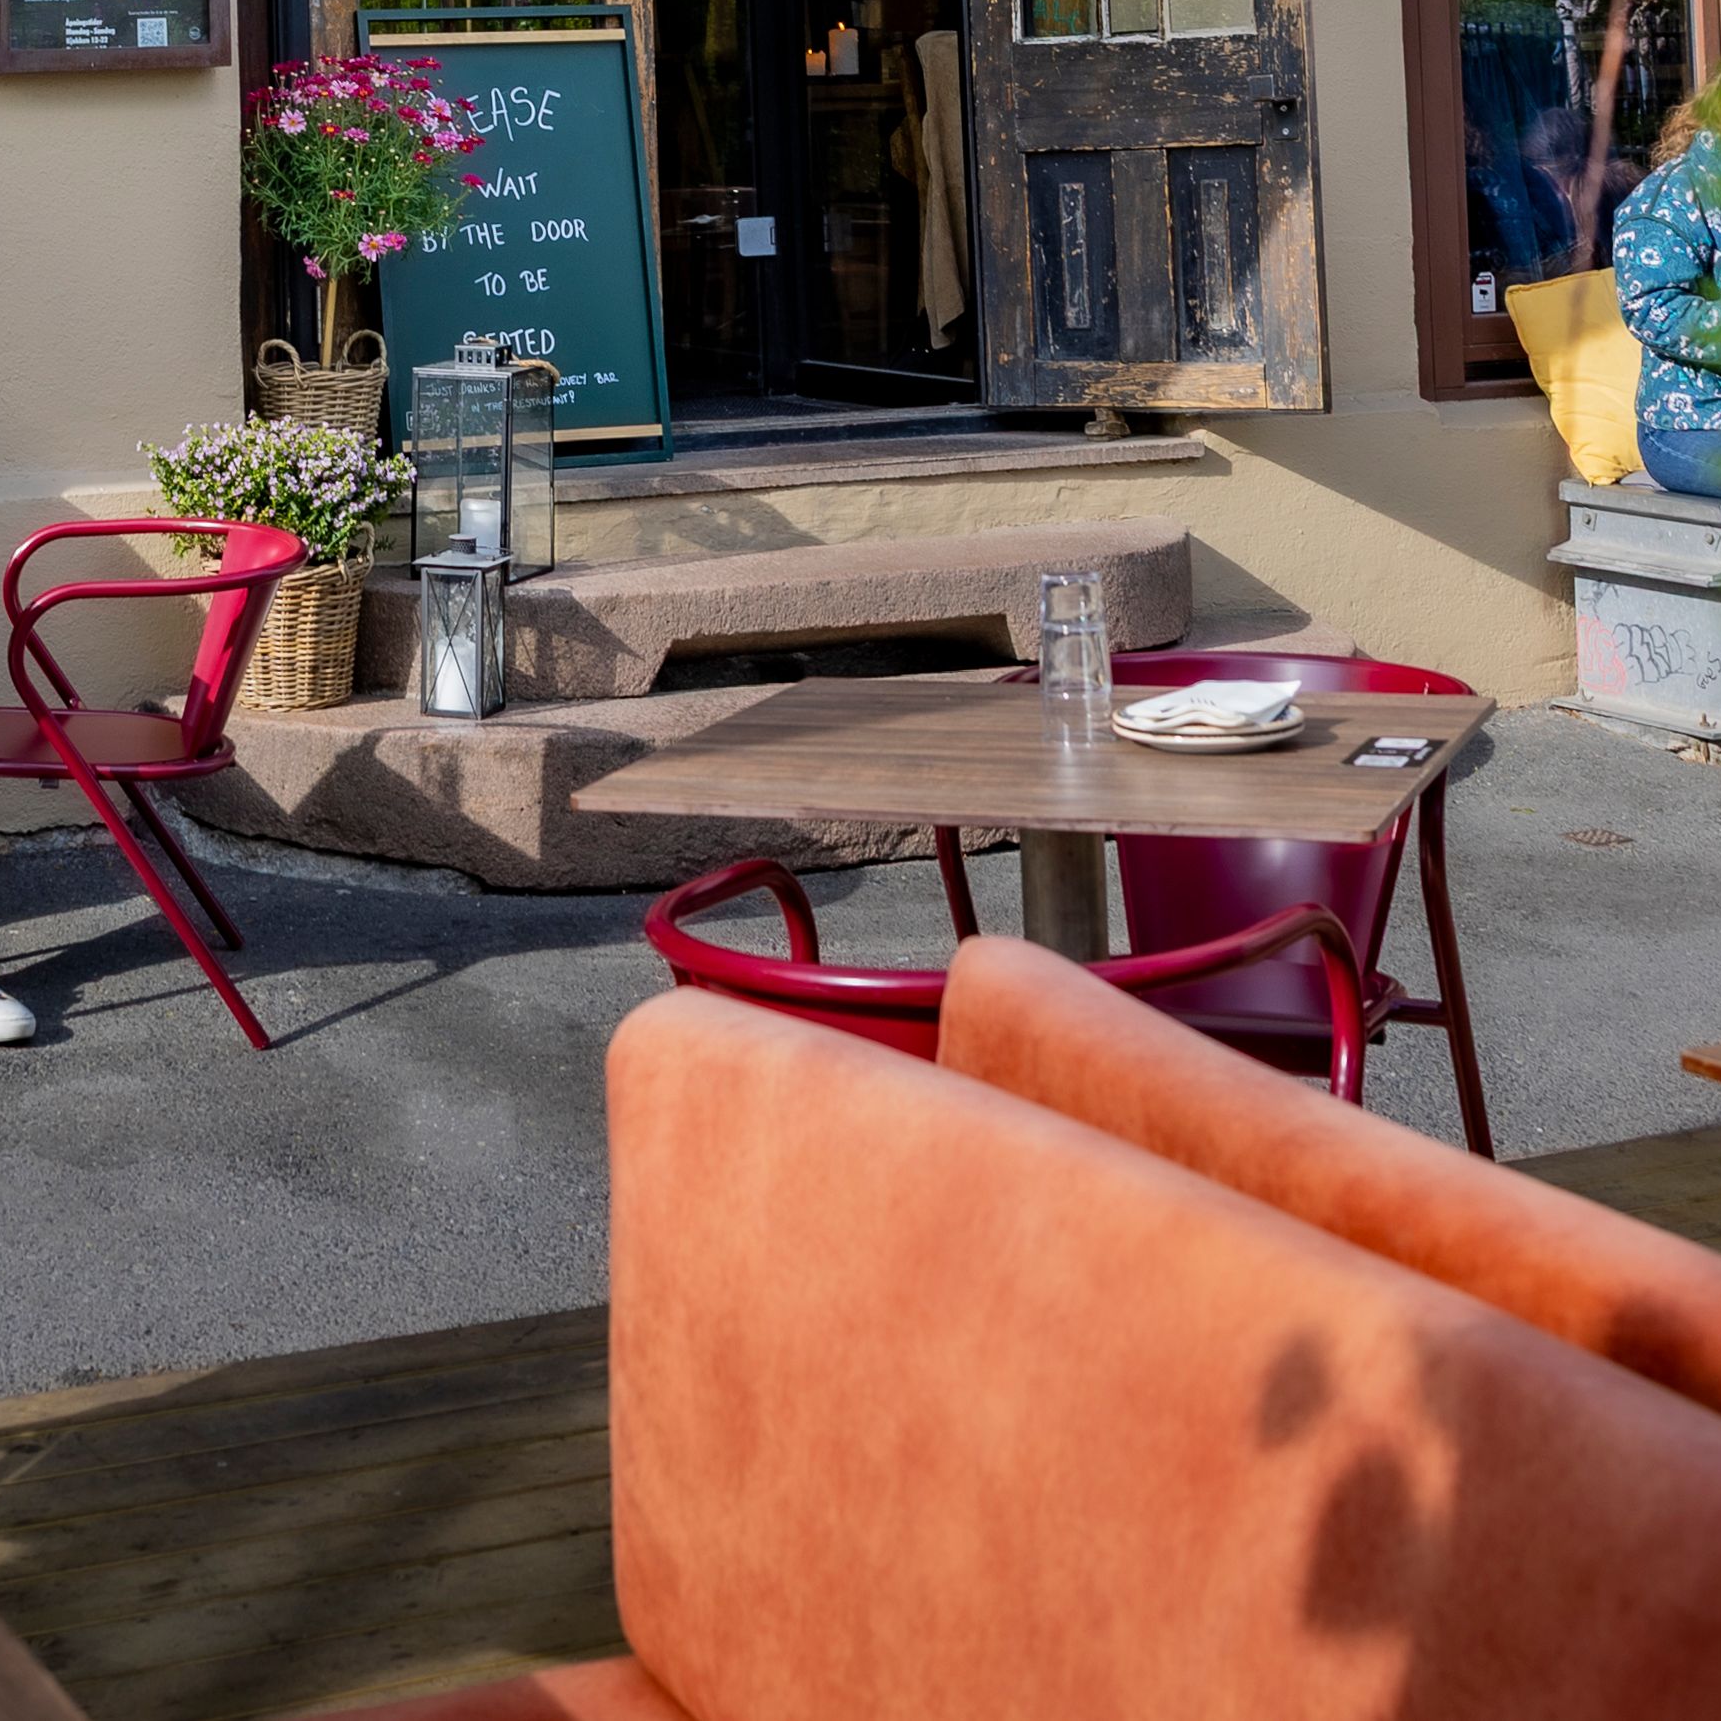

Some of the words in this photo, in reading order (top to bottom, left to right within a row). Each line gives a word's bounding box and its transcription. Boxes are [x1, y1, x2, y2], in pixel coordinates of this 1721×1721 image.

[408, 86, 562, 142] EASE
[476, 166, 539, 201] WAIT
[459, 222, 506, 250] THE
[530, 218, 590, 243] DOOR
[474, 271, 507, 297] TO
[519, 268, 551, 293] BE
[593, 372, 620, 384] BAR
